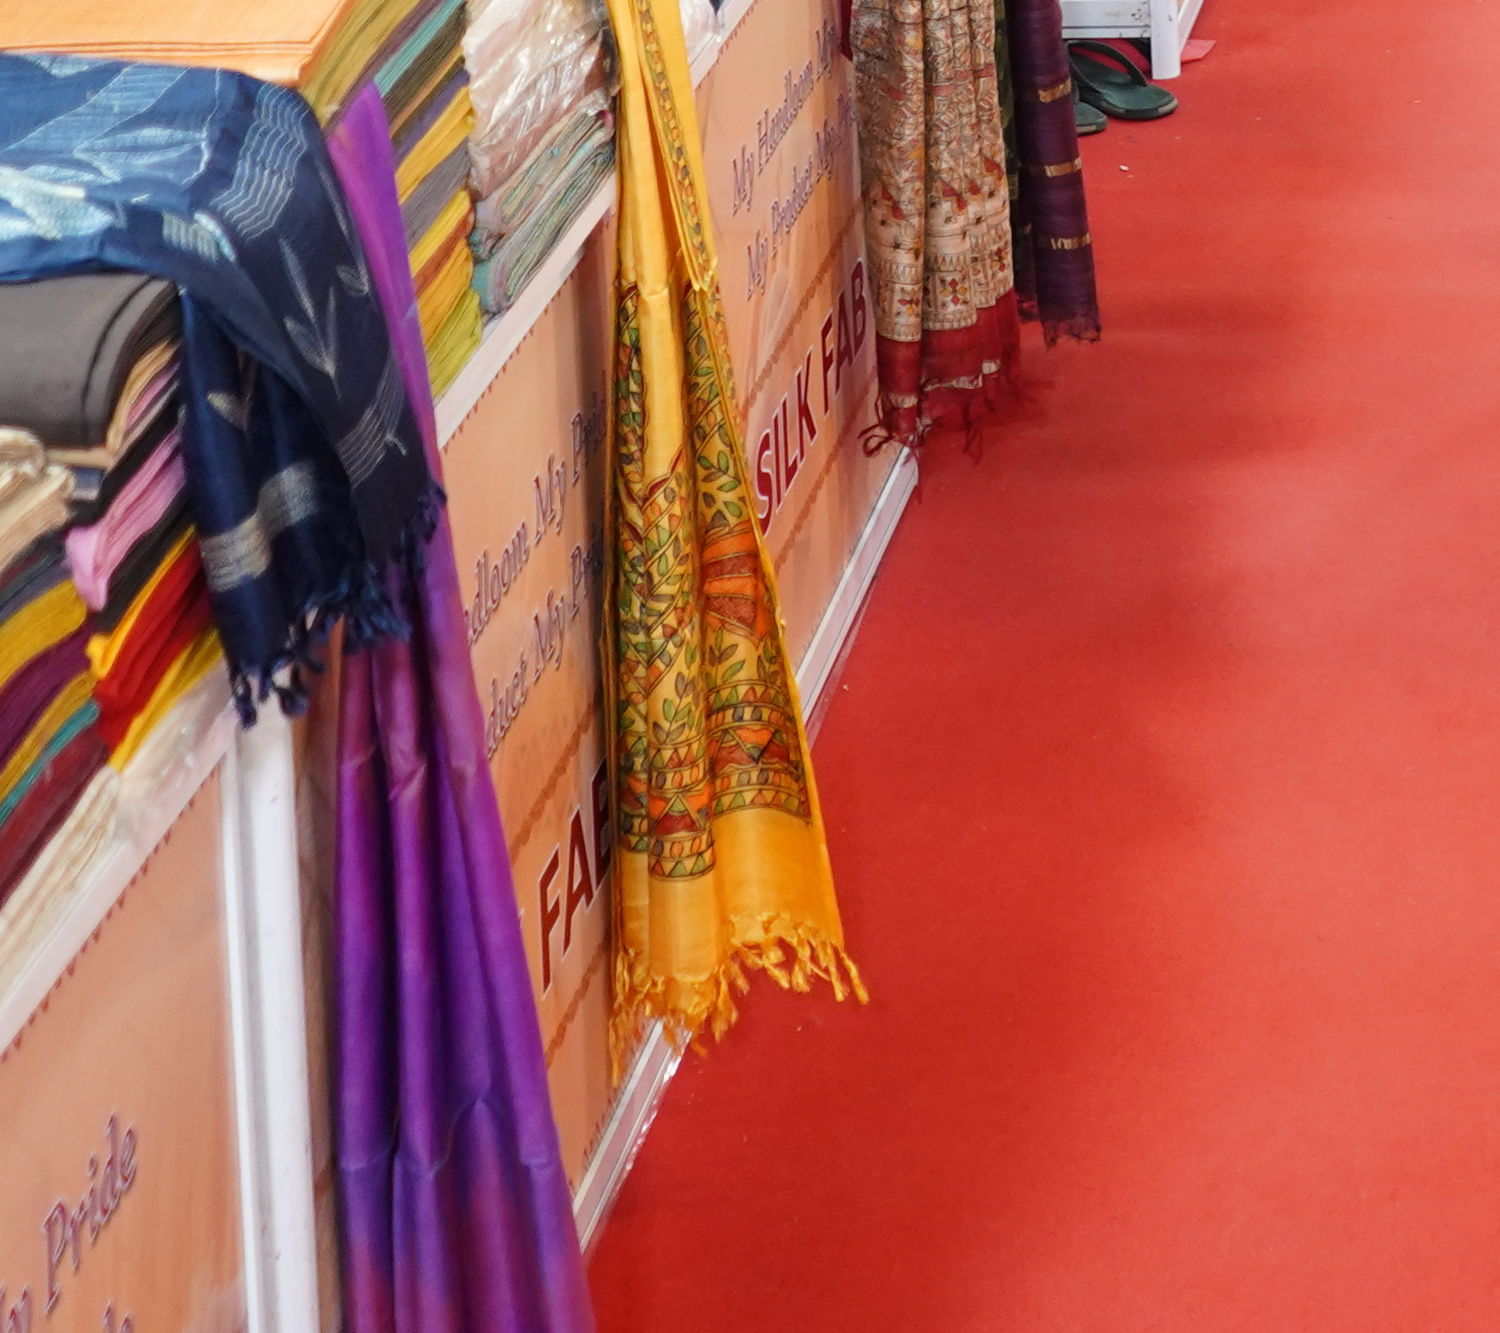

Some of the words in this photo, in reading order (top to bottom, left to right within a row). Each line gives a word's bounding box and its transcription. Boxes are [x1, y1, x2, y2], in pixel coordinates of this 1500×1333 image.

[732, 141, 754, 216] My
[757, 59, 814, 175] Handloom
[746, 229, 768, 302] My
[771, 154, 813, 257] Product
[755, 344, 818, 539] SILK
[820, 257, 867, 419] FAB
[533, 452, 566, 548] My
[486, 651, 528, 760] duct
[532, 588, 566, 683] My
[42, 1109, 138, 1318] Pride
